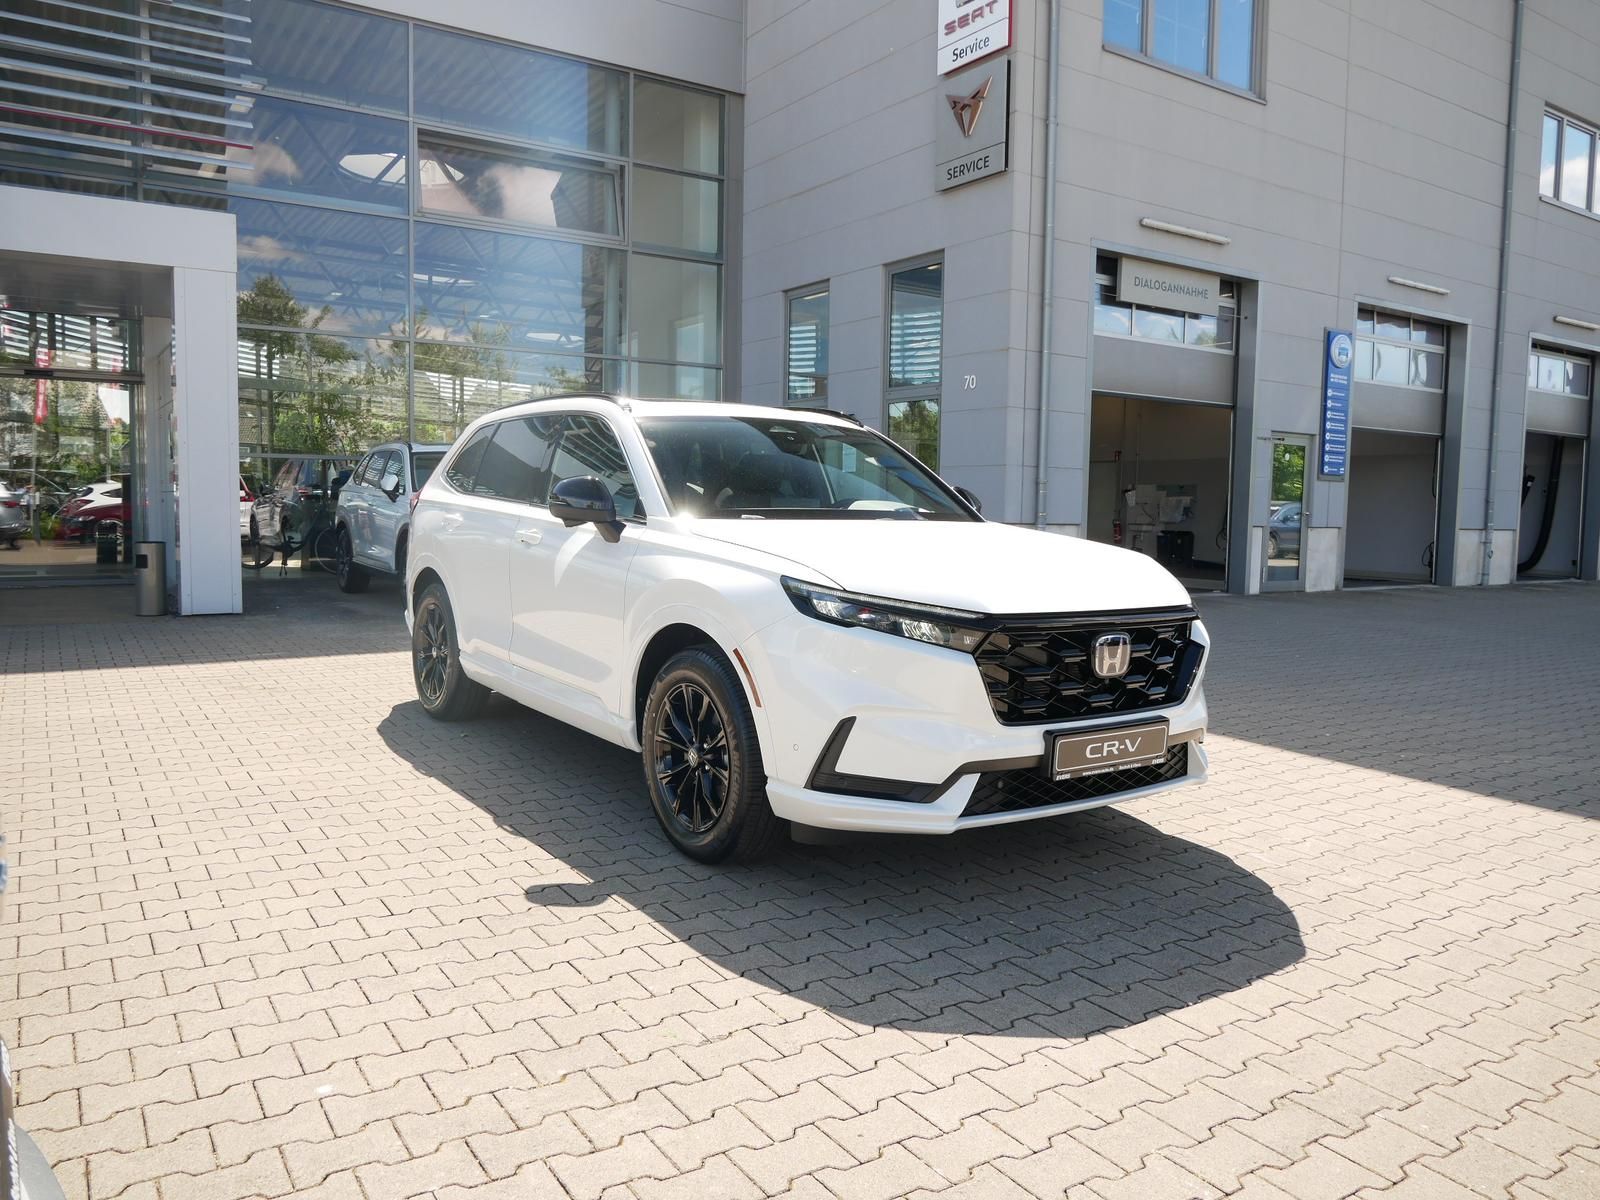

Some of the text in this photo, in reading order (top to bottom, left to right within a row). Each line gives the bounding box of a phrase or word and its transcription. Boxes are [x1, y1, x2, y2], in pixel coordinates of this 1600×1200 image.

[944, 0, 999, 36] SEAT
[952, 36, 990, 62] Service
[947, 155, 990, 181] SERVICE
[1134, 276, 1209, 299] DIALOGANNAHME
[964, 374, 977, 390] 70
[1085, 737, 1142, 759] CR-V
